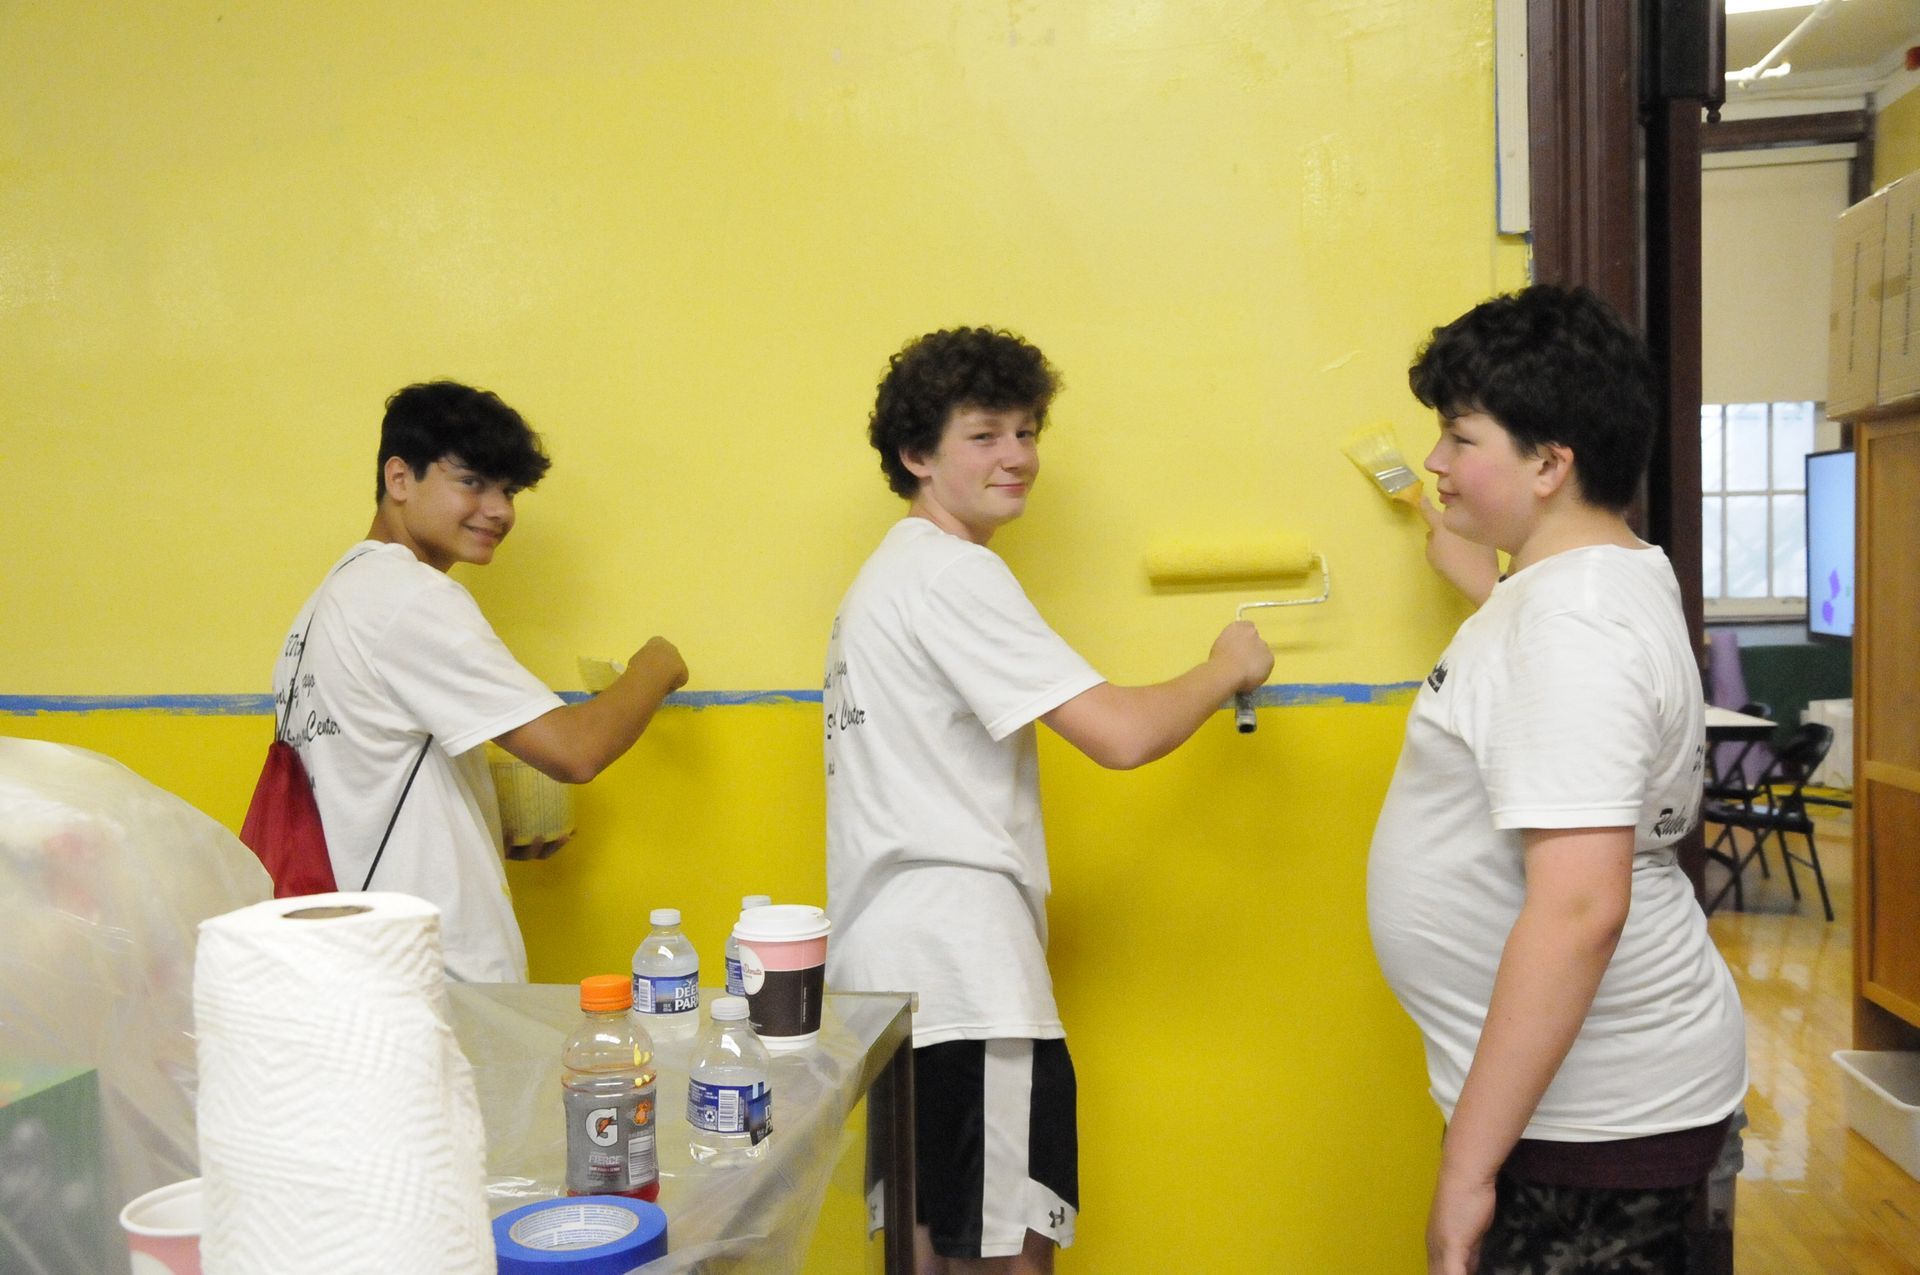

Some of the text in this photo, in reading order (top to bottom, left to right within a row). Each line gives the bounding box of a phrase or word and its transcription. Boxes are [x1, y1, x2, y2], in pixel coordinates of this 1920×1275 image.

[307, 710, 341, 742] Center
[675, 984, 698, 999] DEE
[675, 995, 699, 1011] PAR
[586, 1107, 618, 1147] G
